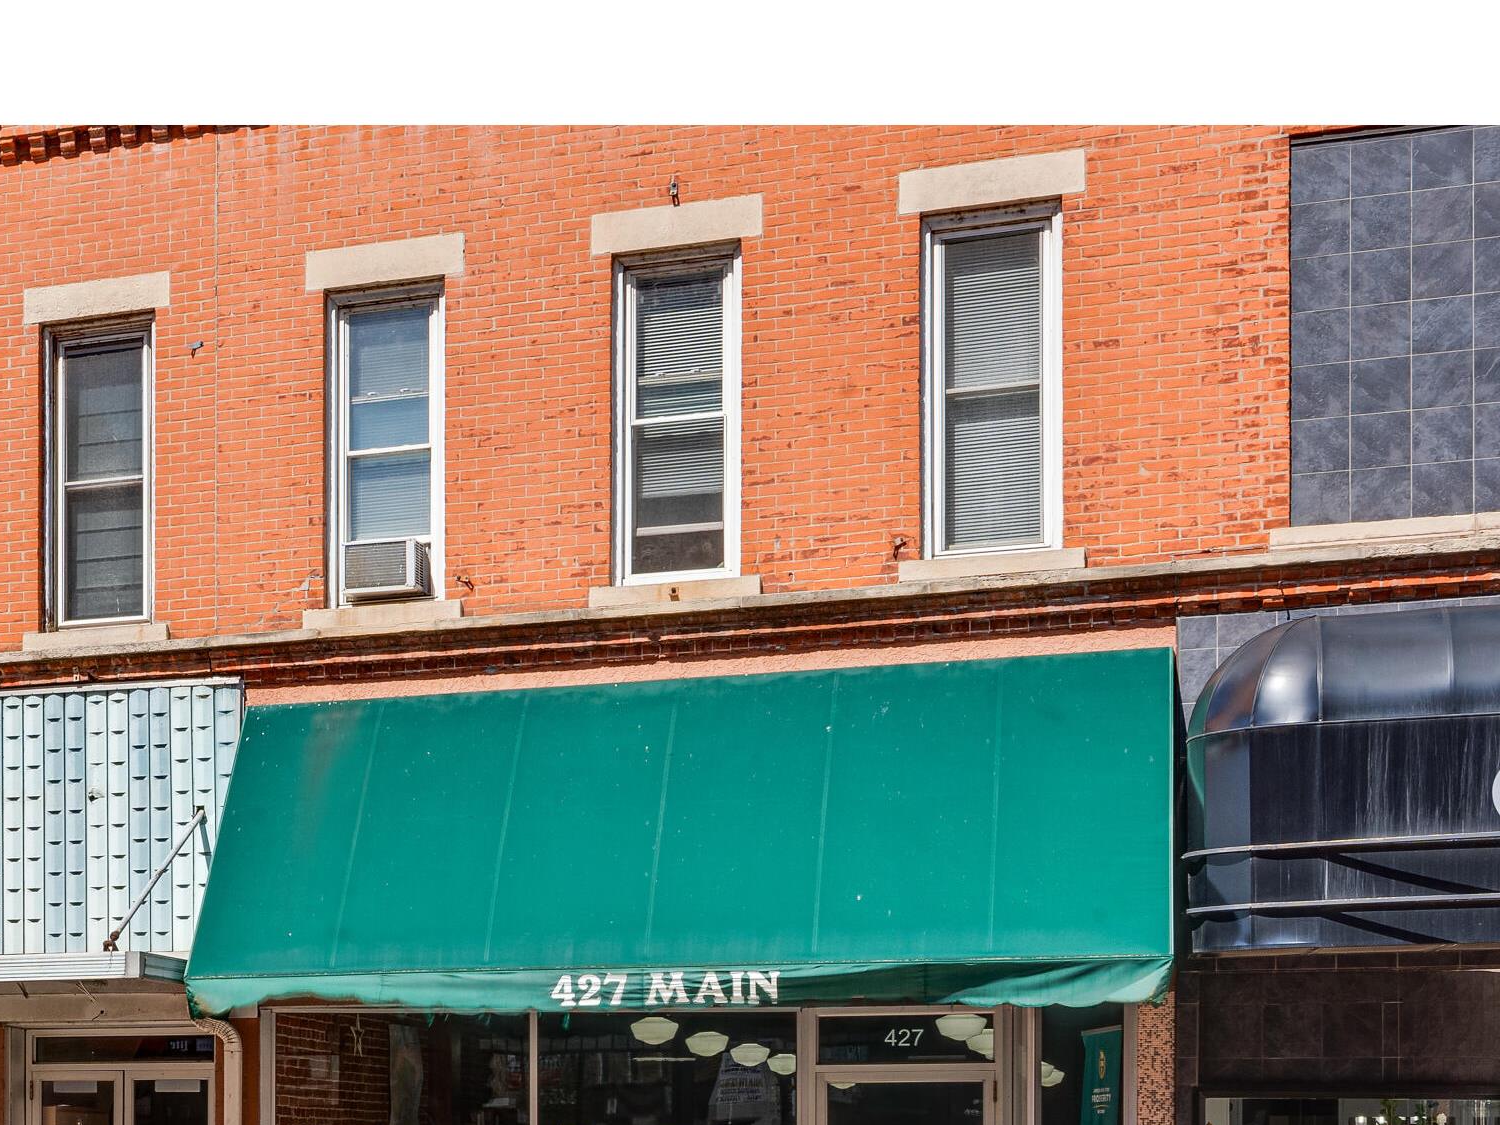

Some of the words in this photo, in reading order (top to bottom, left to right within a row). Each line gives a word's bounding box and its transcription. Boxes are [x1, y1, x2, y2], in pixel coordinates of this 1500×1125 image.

[550, 973, 628, 1006] 427
[645, 971, 780, 1006] MAIN
[884, 1028, 924, 1047] 427
